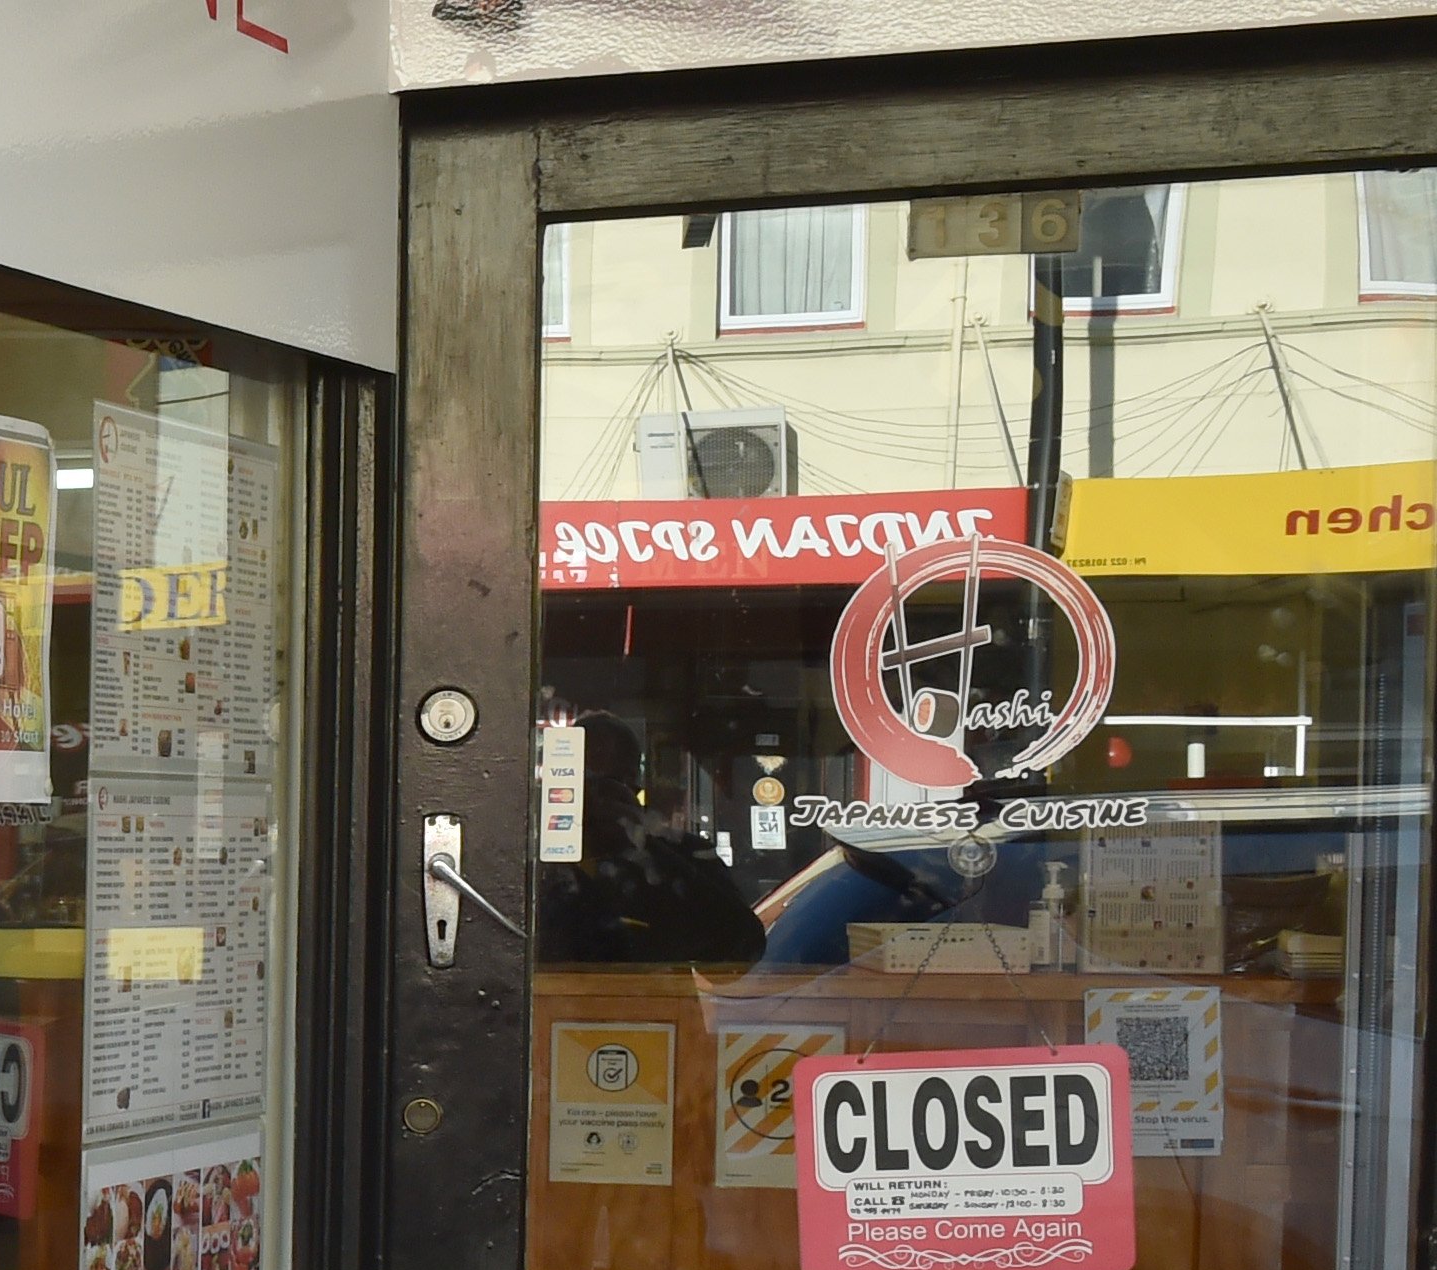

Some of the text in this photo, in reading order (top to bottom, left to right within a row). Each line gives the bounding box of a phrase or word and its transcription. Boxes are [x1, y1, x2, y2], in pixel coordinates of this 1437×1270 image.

[925, 199, 1068, 248] 136
[551, 768, 575, 776] VISA
[823, 1074, 1100, 1174] CLOSED
[1134, 1115, 1209, 1124] Stop the virus.
[854, 1180, 948, 1191] WILL RETURN:
[854, 1197, 888, 1206] CALL
[847, 1218, 1082, 1243] Please Come Again
